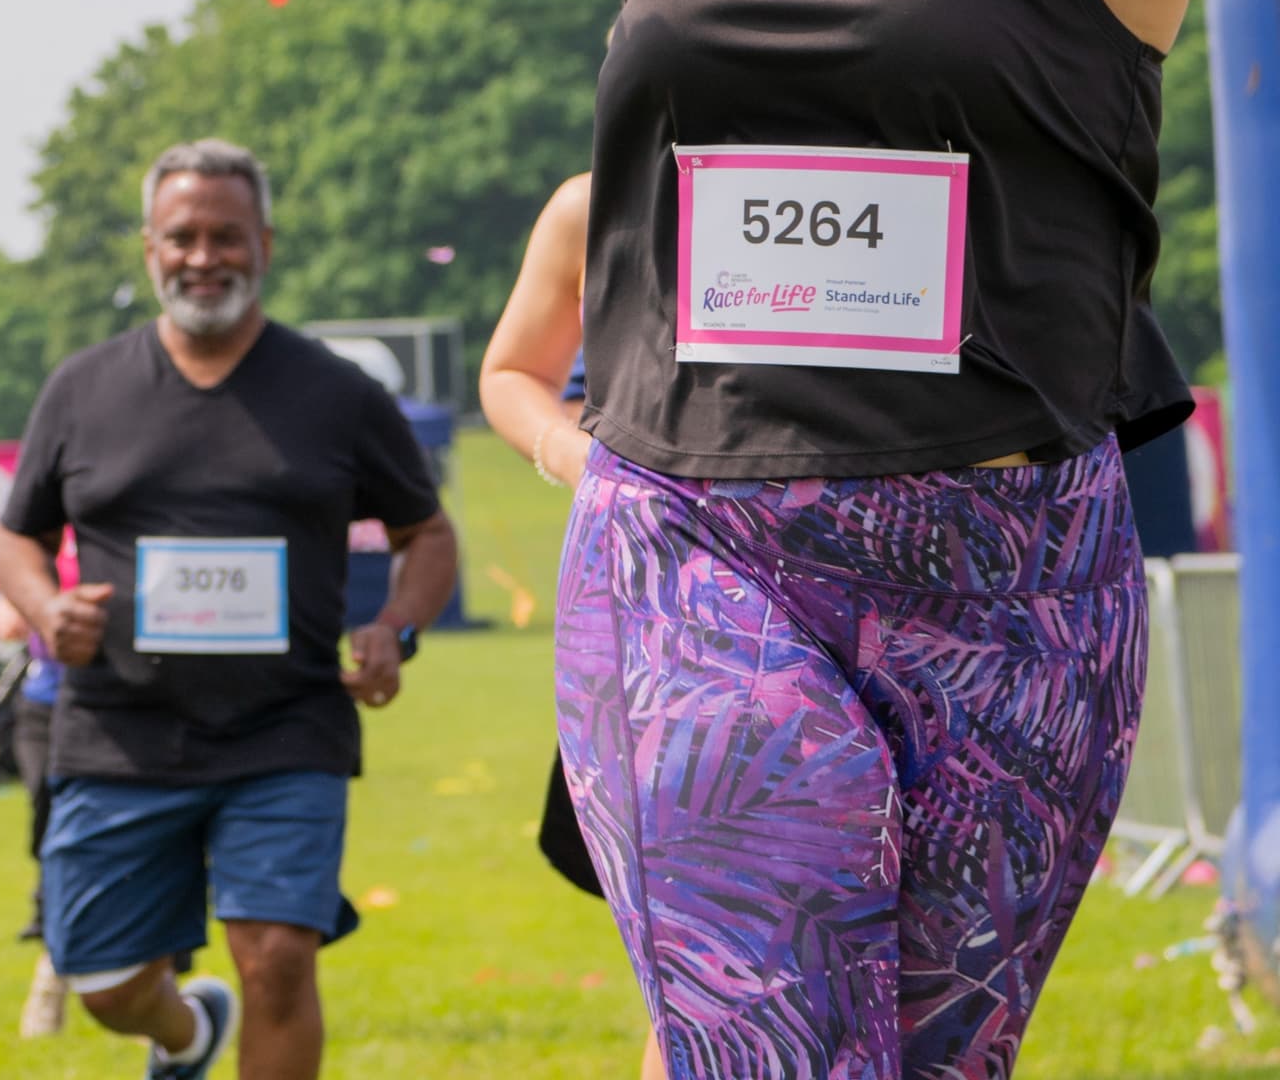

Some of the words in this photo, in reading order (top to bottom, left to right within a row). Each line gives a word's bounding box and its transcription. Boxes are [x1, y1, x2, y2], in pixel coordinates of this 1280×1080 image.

[742, 199, 884, 249] 5264
[703, 287, 743, 312] Race
[746, 287, 770, 305] for
[770, 283, 817, 307] Life
[825, 289, 890, 305] Standard
[893, 293, 921, 307] Life
